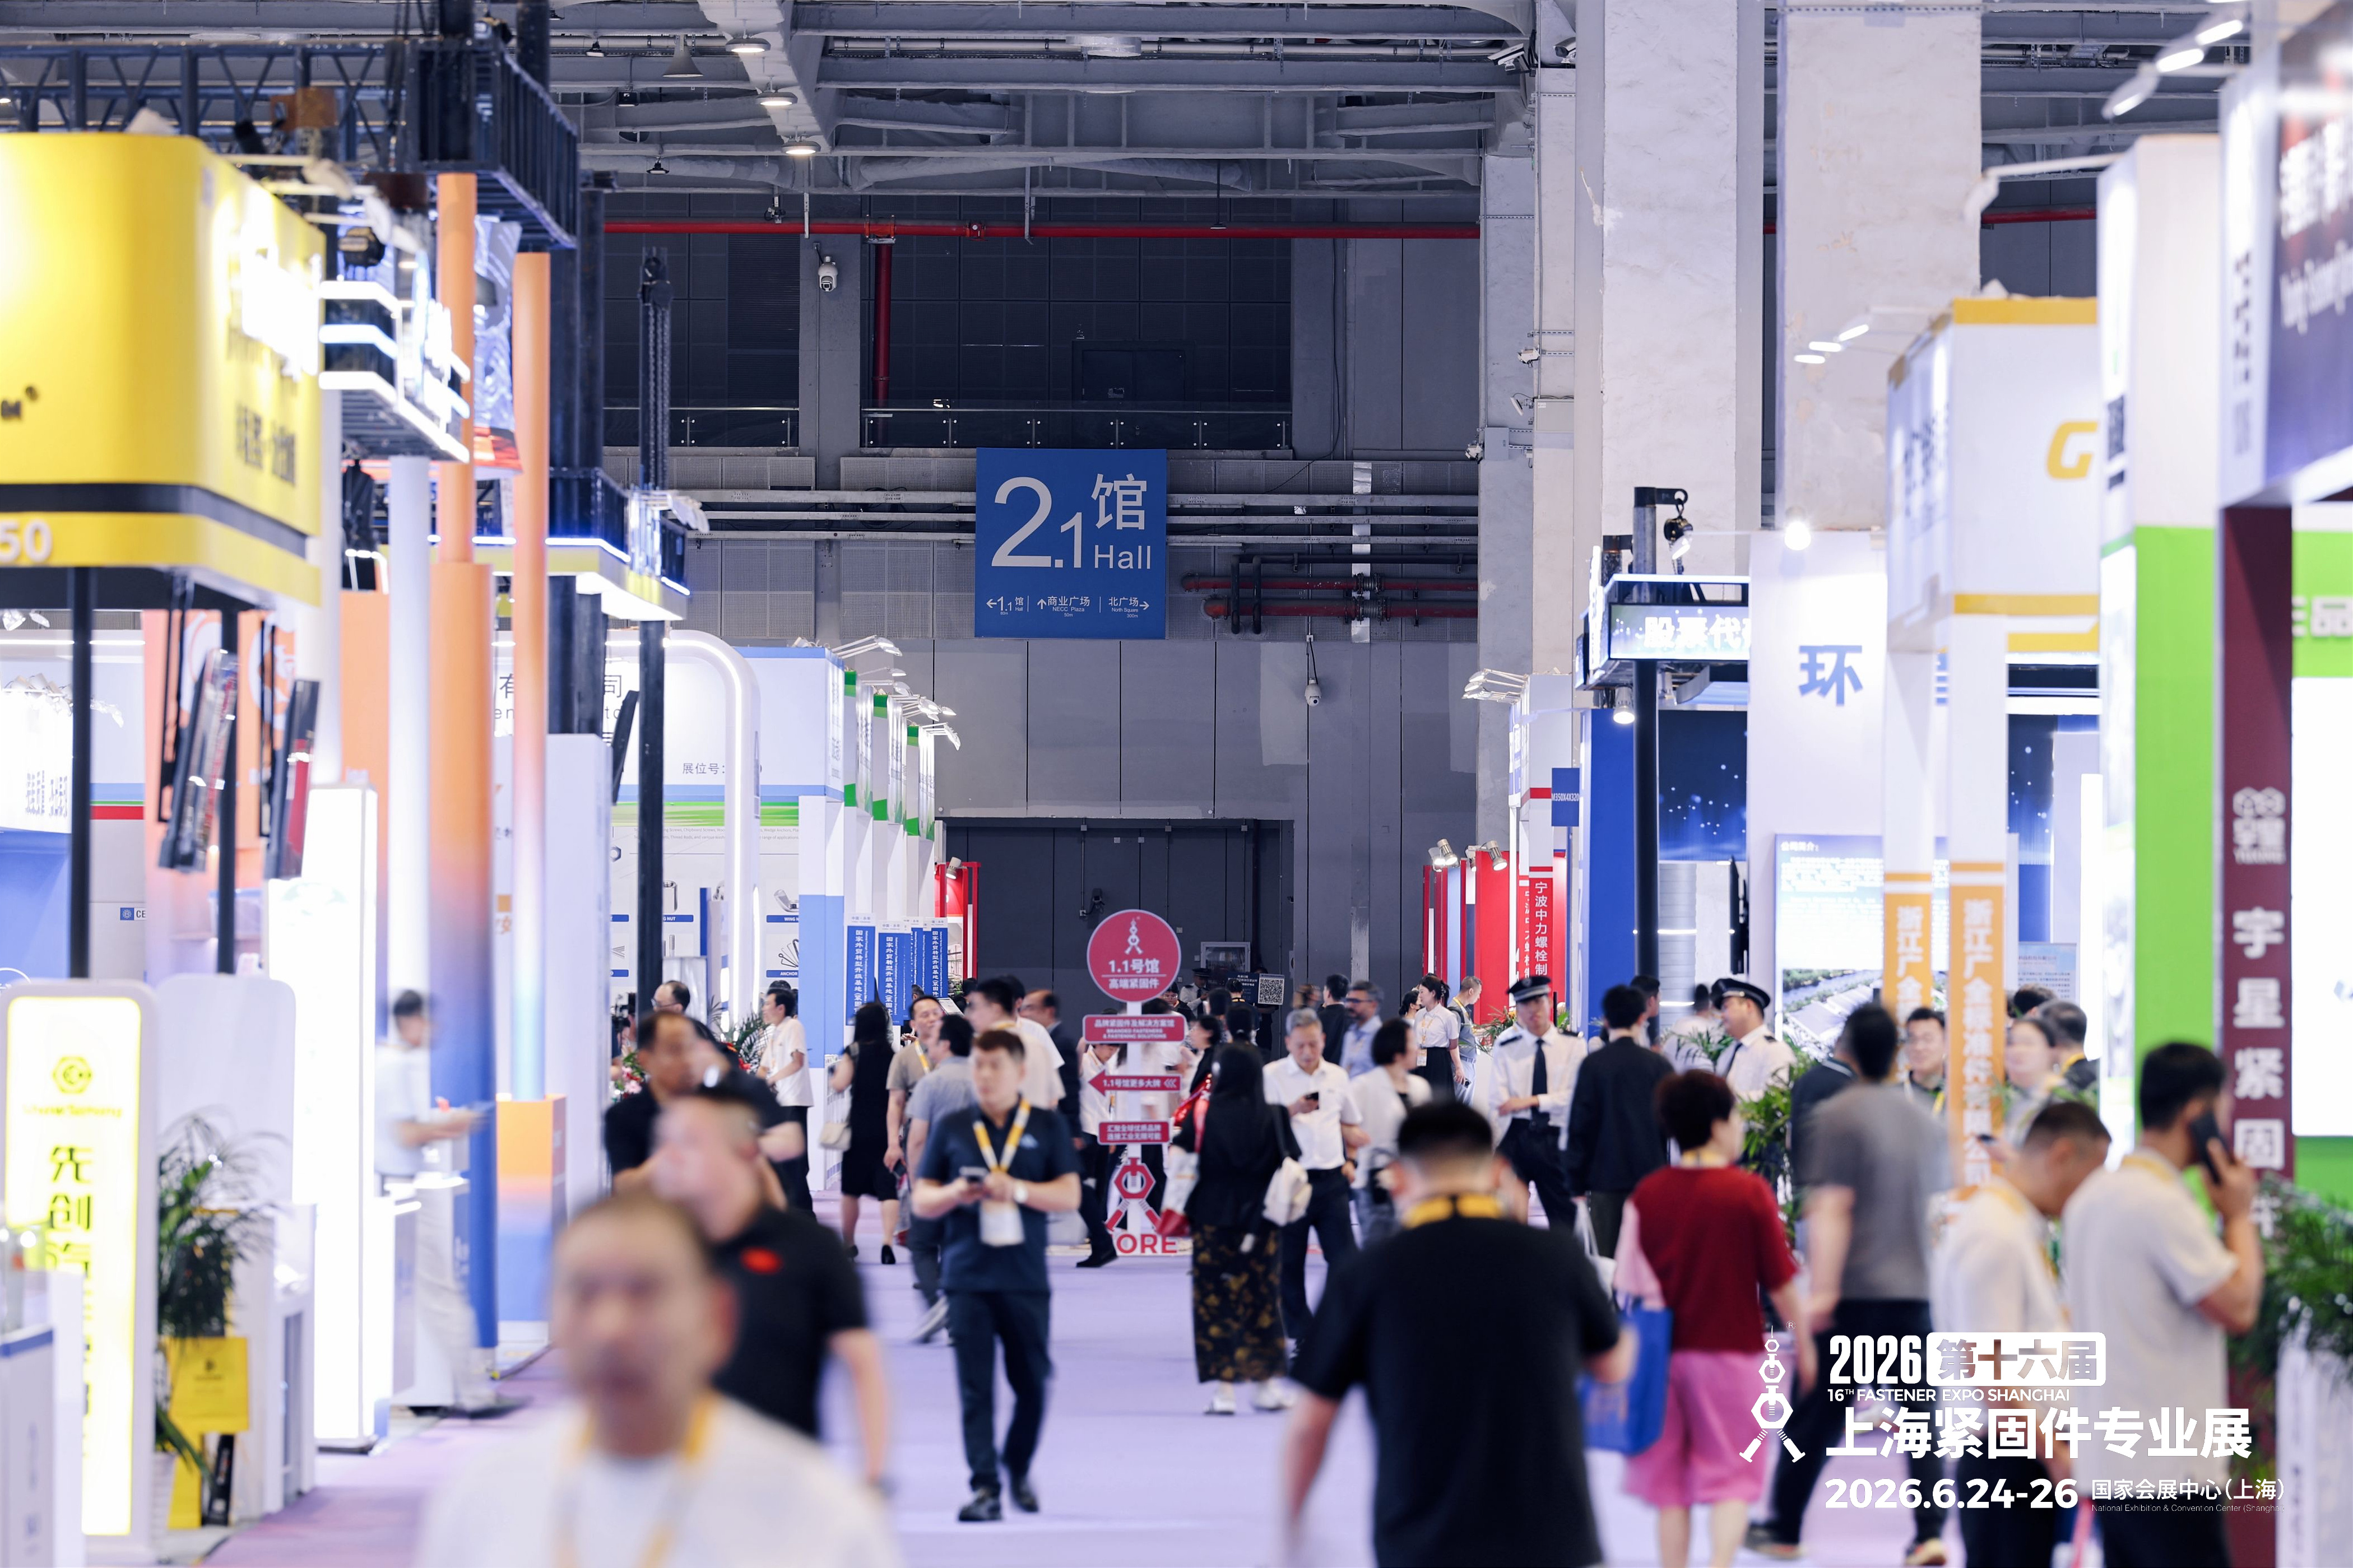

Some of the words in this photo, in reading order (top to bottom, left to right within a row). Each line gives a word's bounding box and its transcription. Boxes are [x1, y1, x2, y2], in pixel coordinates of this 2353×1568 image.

[2045, 420, 2099, 480] G
[1091, 473, 1147, 530] 馆
[991, 476, 1082, 568] 2.1
[1094, 545, 1151, 569] Hall
[997, 596, 1012, 611] 1.1
[1015, 597, 1024, 606] 馆
[1047, 596, 1090, 607] 商业广场
[1108, 597, 1139, 607] 北广场
[1799, 645, 1863, 706] 环
[1551, 793, 1579, 802] M350X4X320
[1535, 881, 1548, 976] 宁波中力螺栓制
[1108, 959, 1159, 974] 1.1号馆
[1112, 1234, 1177, 1254] ORE
